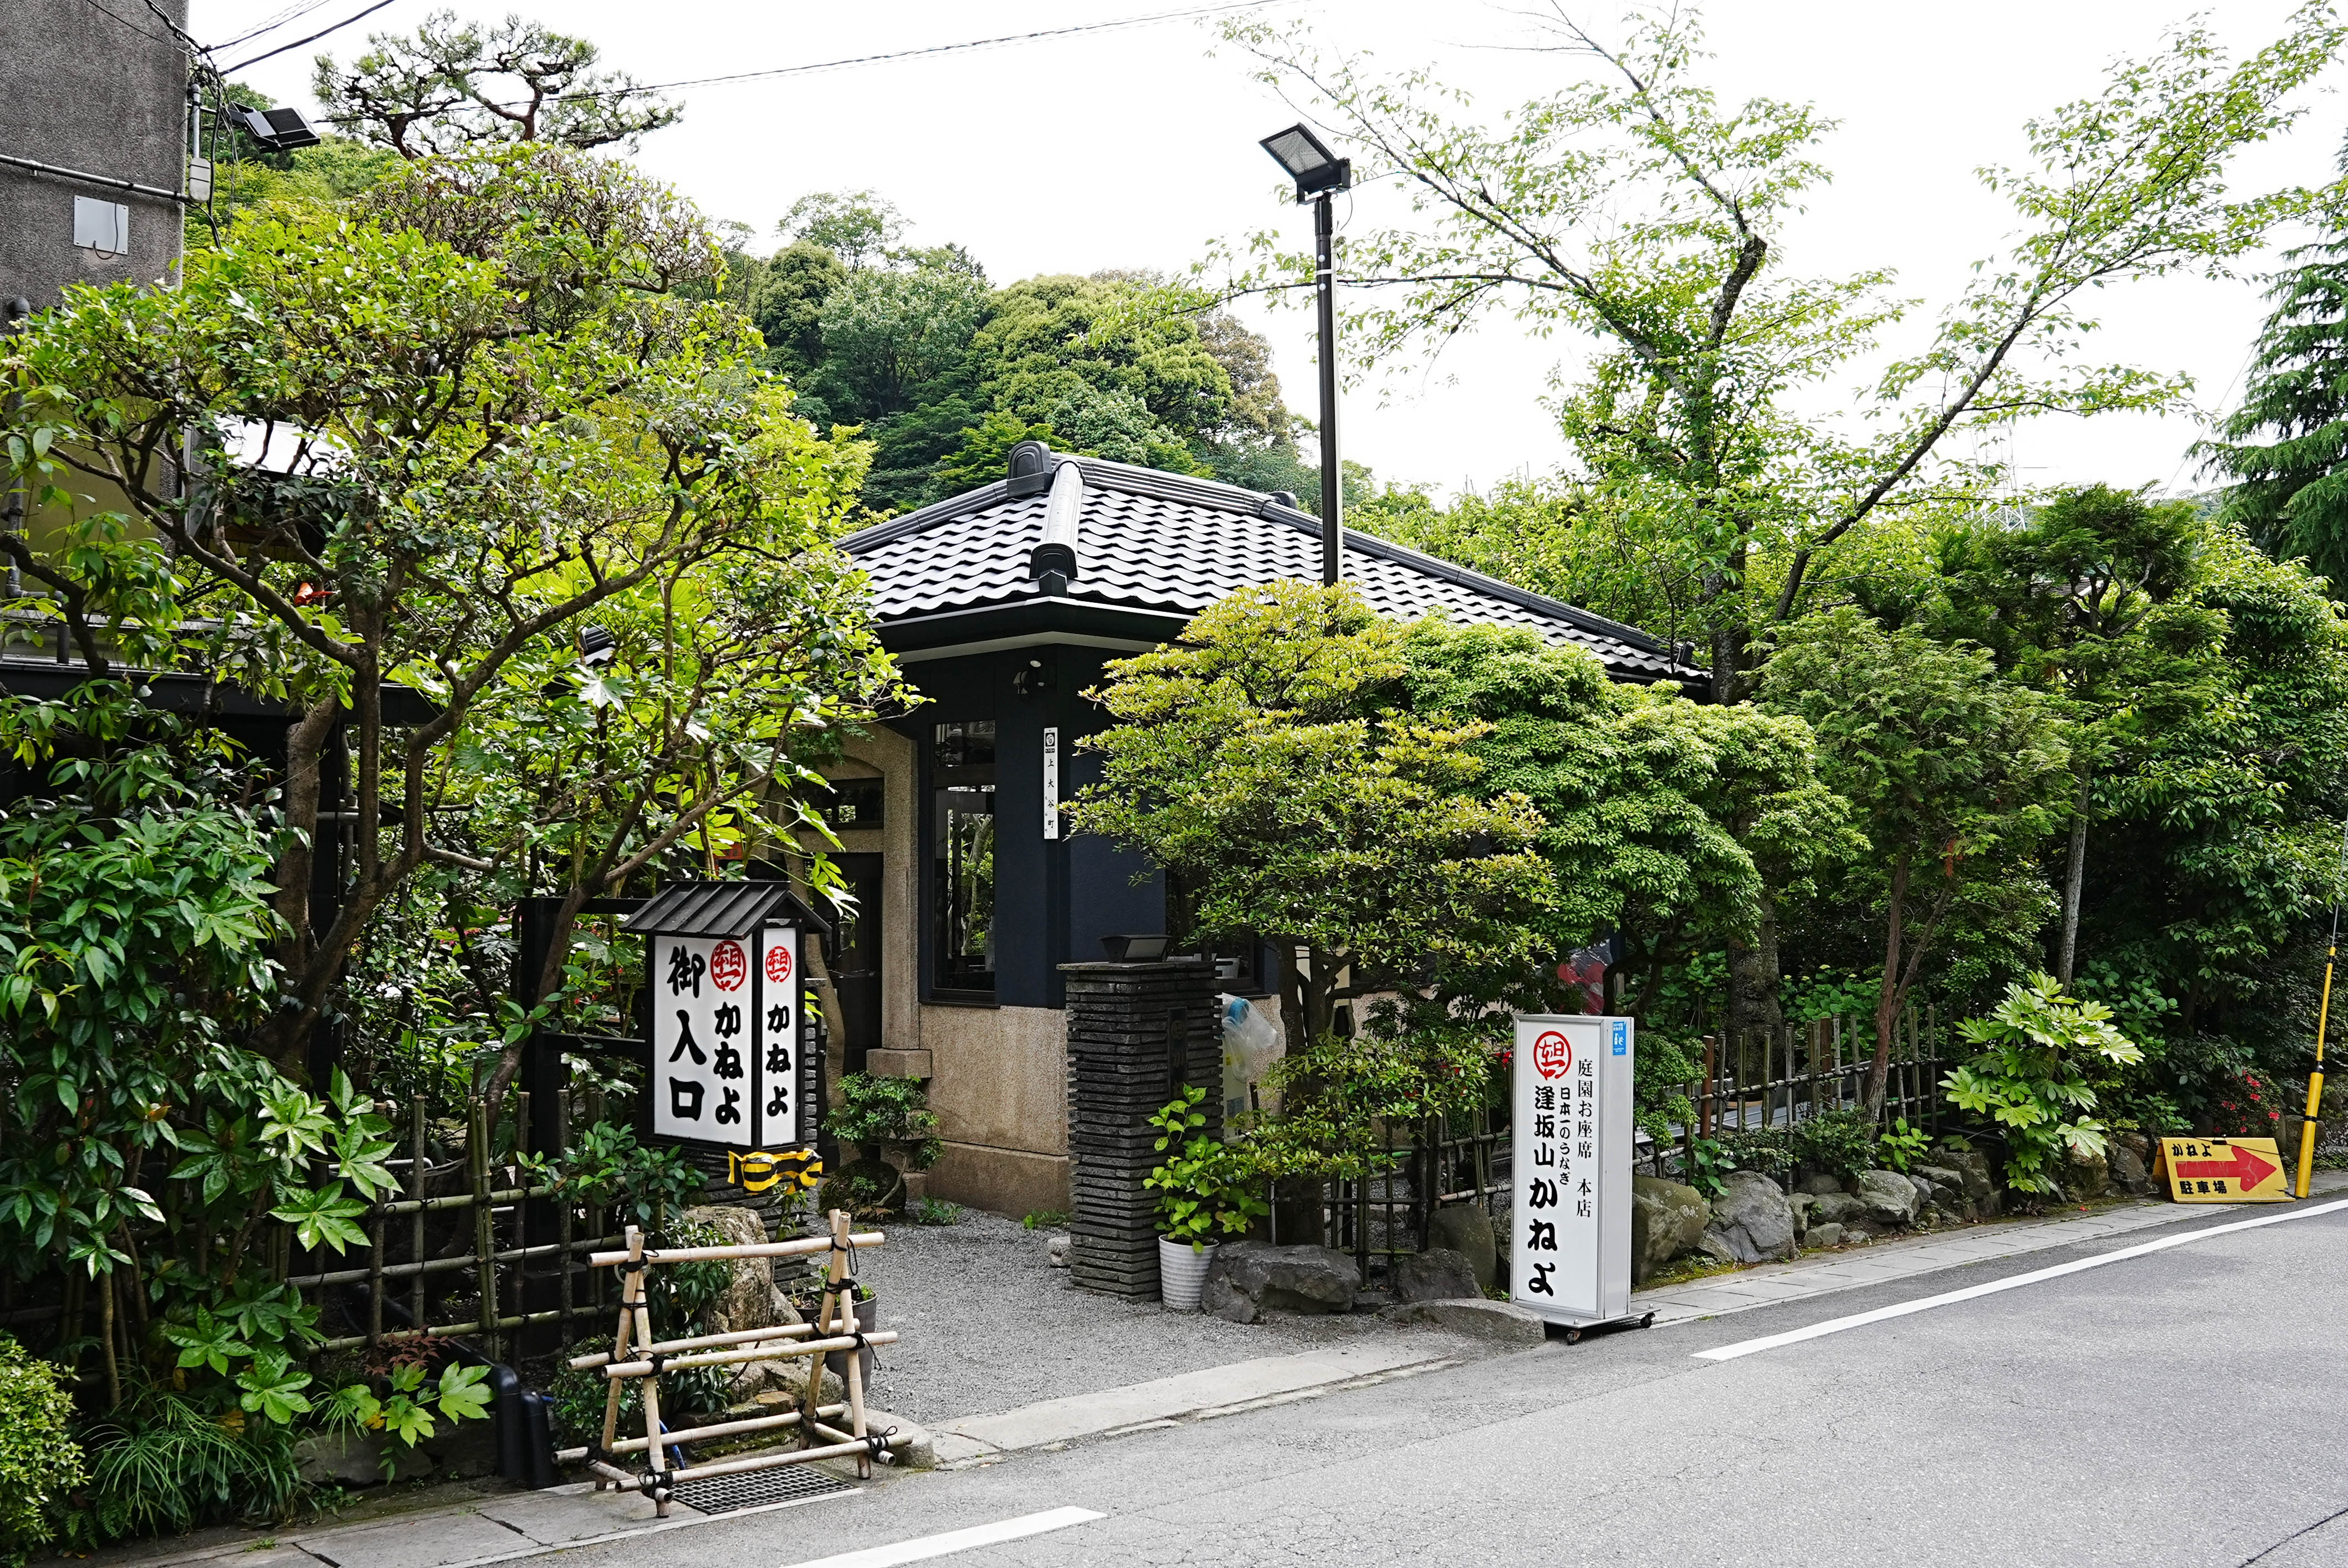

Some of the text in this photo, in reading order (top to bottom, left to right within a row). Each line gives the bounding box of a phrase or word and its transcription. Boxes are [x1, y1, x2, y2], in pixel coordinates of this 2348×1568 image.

[667, 945, 707, 1121] 御入口
[713, 1002, 744, 1125] かねよ
[766, 1003, 791, 1117] かねよ
[1528, 1085, 1558, 1297] 逢坂山かねよ
[1559, 1087, 1571, 1185] 日本一のうなぎ
[1577, 1058, 1593, 1218] 庭園お座席 本店
[2171, 1142, 2212, 1157] かねよ
[2179, 1180, 2227, 1195] 駐車場
